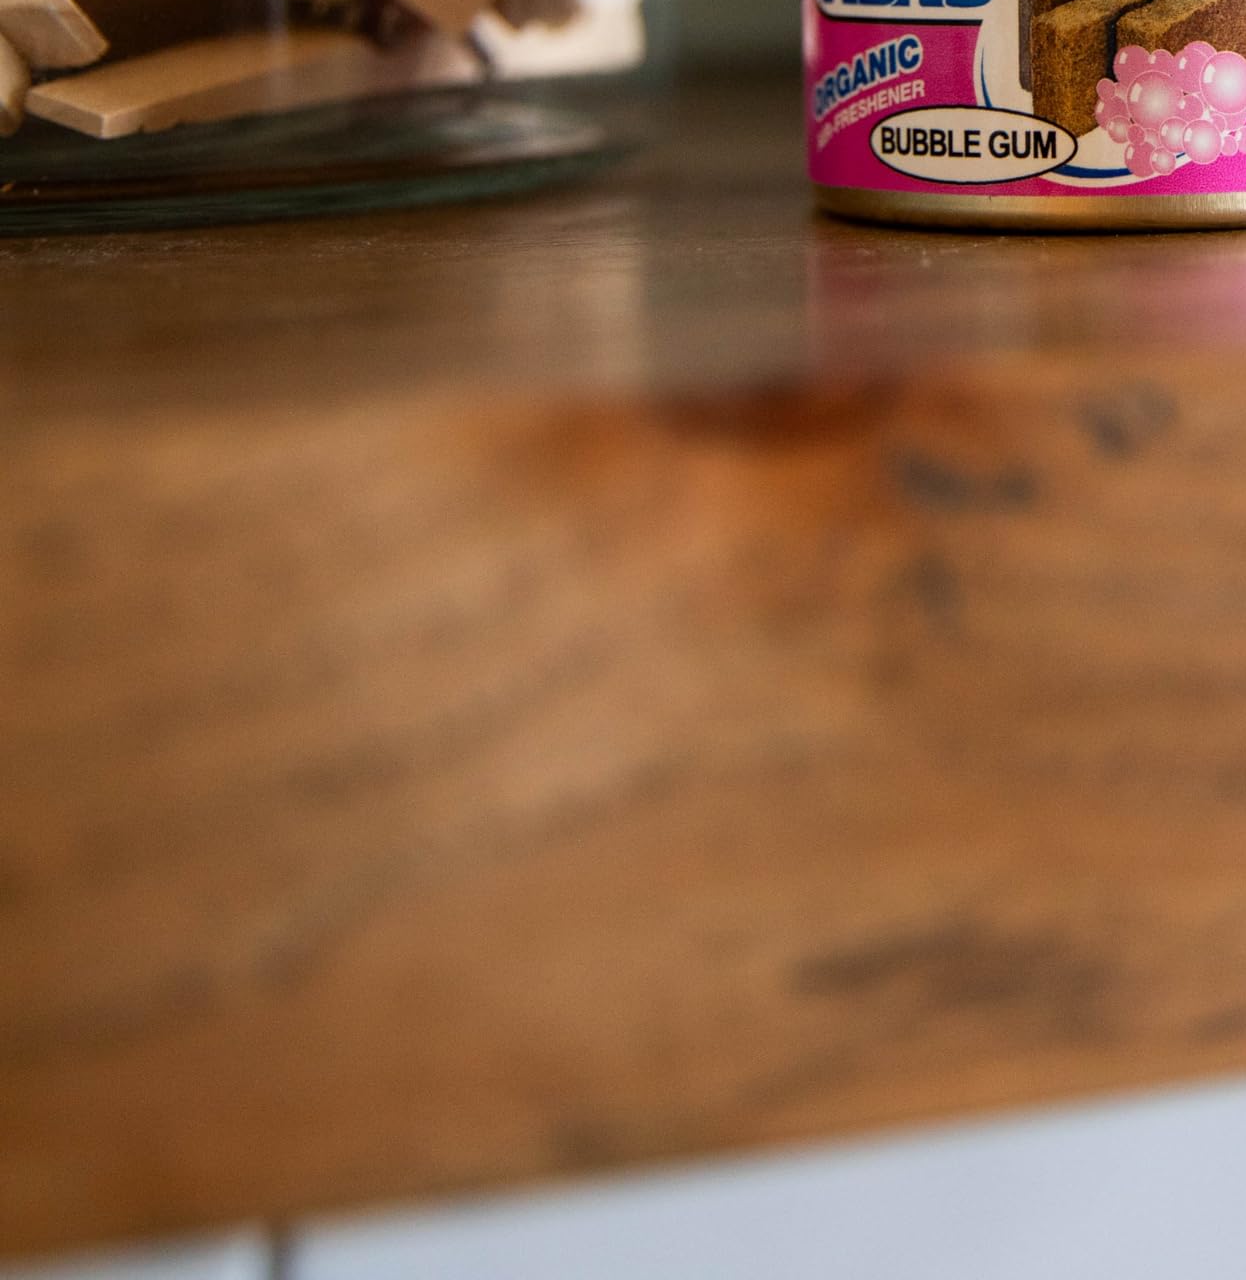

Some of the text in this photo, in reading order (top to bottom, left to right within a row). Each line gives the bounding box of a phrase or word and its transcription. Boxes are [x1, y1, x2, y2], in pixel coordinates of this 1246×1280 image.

[815, 36, 922, 117] ORGANIC
[880, 126, 1057, 159] BUBBLE GUM
